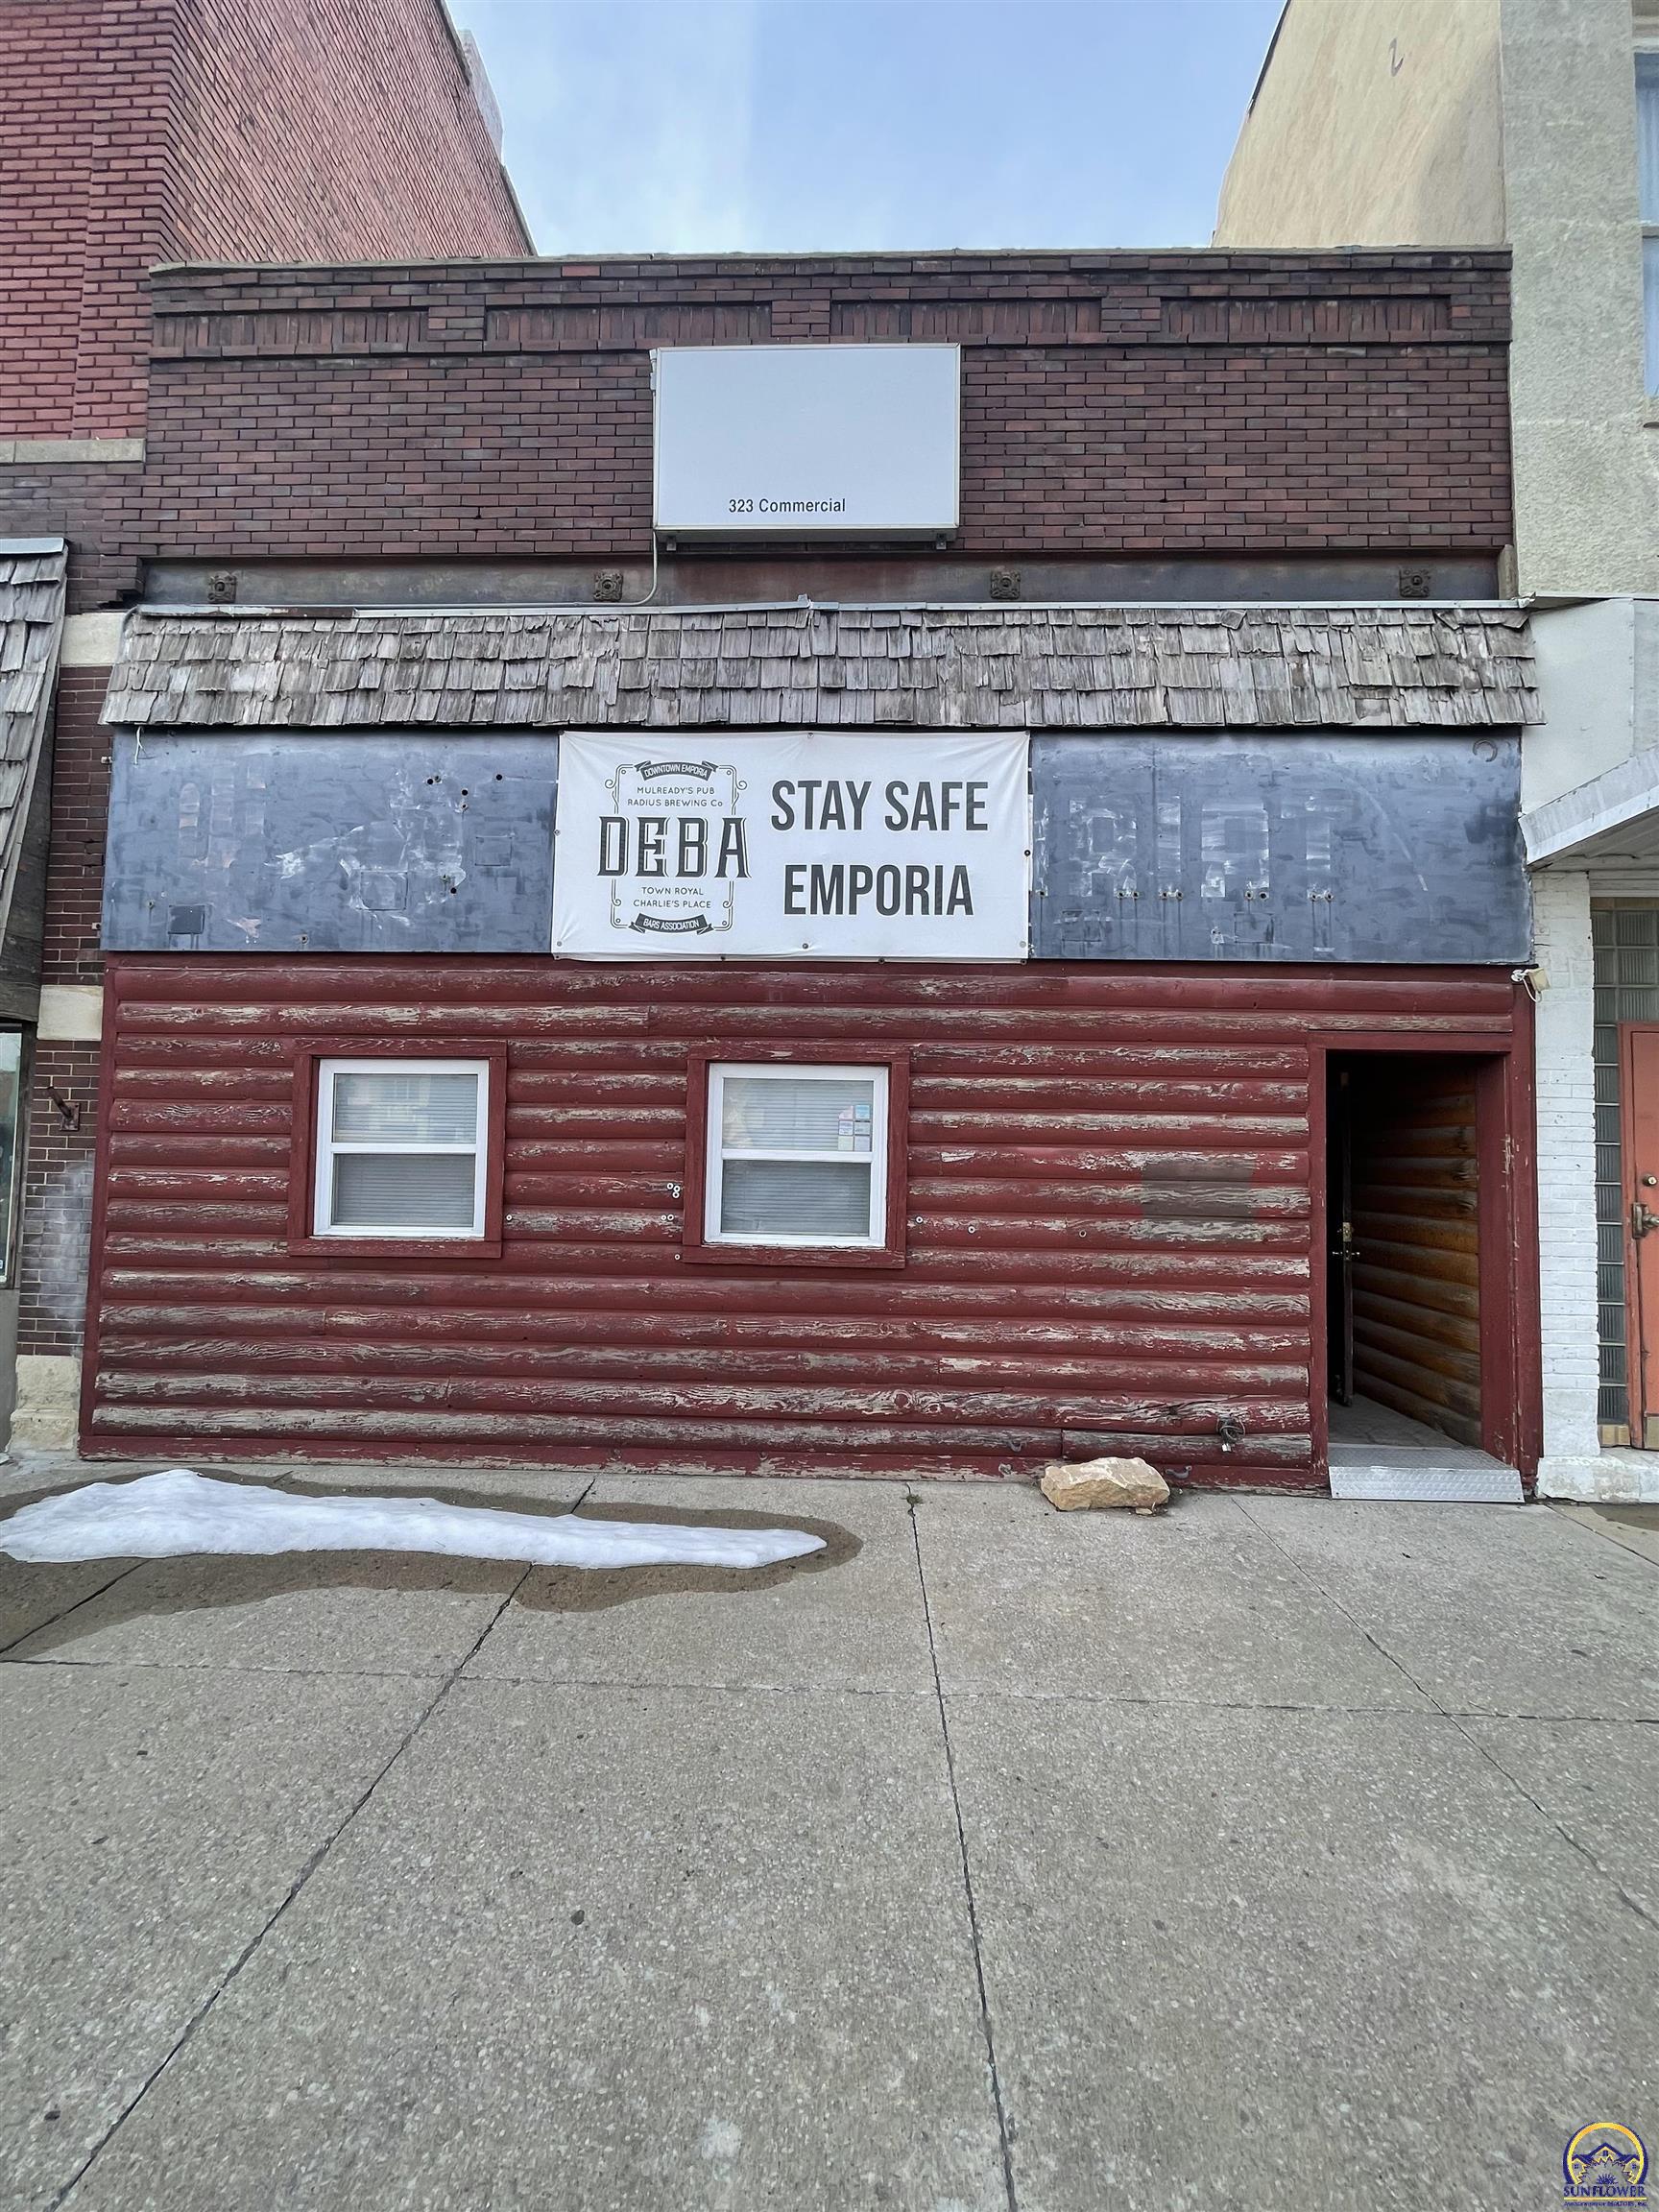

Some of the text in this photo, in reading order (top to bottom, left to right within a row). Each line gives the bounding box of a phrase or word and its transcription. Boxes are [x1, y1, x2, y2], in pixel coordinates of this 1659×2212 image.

[729, 498, 846, 513] 323 Commercial
[644, 764, 708, 778] DOWNTOWN EMPORIA
[637, 786, 715, 795] MULREADY'S PUB
[664, 799, 708, 807] BREWING
[710, 799, 723, 807] Co
[771, 780, 989, 831] STAY SAFE
[597, 816, 753, 878] DEBA
[641, 886, 704, 896] TOWN ROYAL
[783, 864, 974, 916] EMPORIA
[633, 899, 711, 909] CHARLIE'S PLACE
[643, 918, 700, 931] BARS ASSOCIATION
